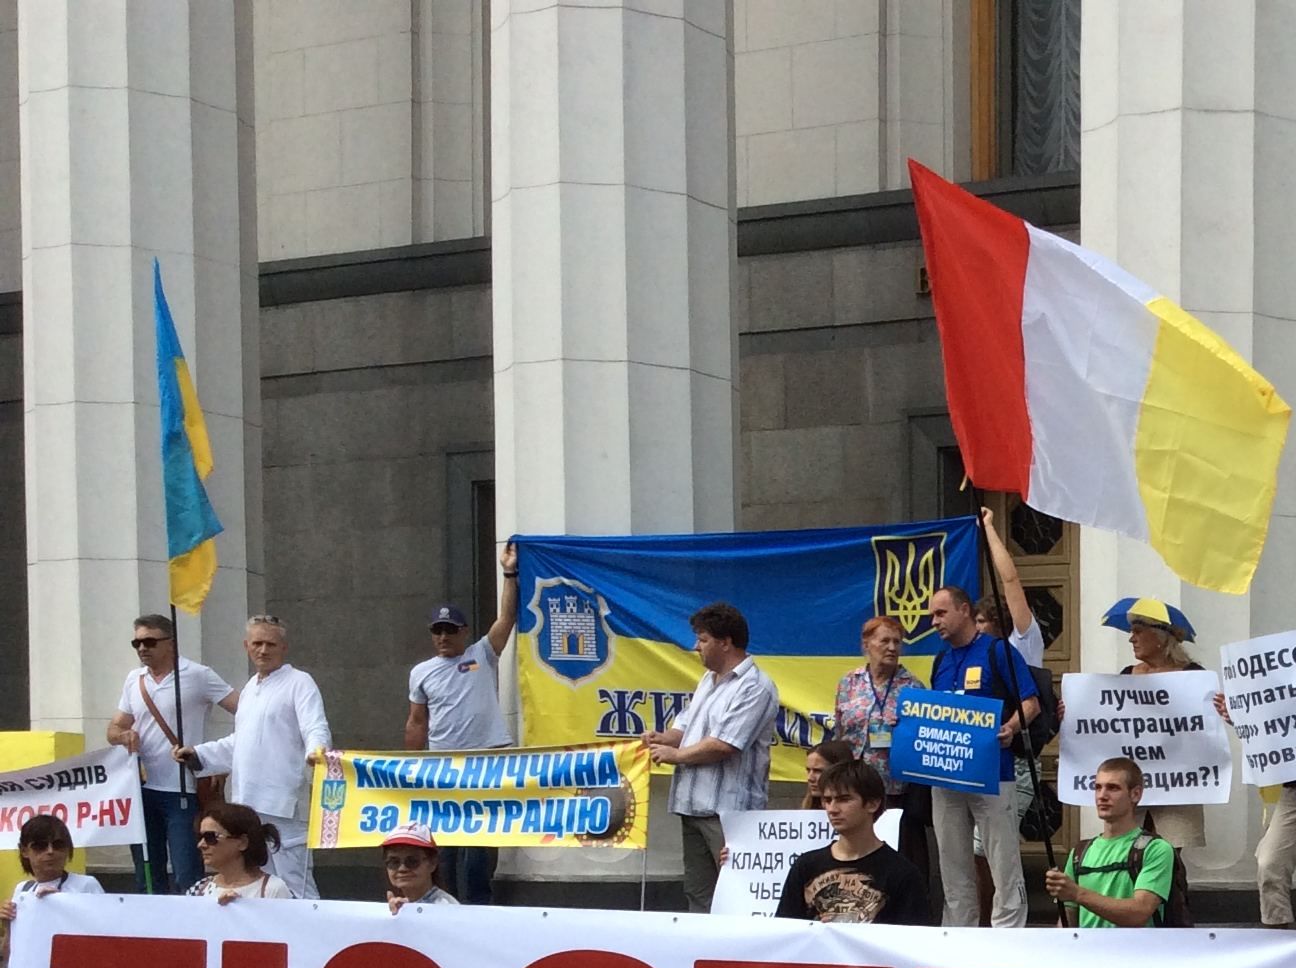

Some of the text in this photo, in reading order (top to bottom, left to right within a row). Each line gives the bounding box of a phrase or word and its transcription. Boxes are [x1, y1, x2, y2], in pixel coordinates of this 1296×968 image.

[1100, 689, 1170, 711] лучше
[901, 700, 996, 729] ЗАПОРІЖЖЯ
[918, 726, 972, 744] ВИМАГАЄ
[1075, 715, 1204, 738] люстрация
[914, 739, 974, 759] ОЧИСТИТИ
[1121, 745, 1166, 761] чем
[352, 751, 621, 789] ХМЕЛЬНИЧЧИНА
[922, 754, 964, 772] ВЛАДУ!
[25, 765, 107, 791] СУДДІВ
[77, 797, 132, 828] Р-НУ
[360, 797, 611, 839] за ЛЮСТРАЦІЮ
[758, 822, 802, 840] КАБЫ
[732, 852, 784, 874] КЛАДЯ
